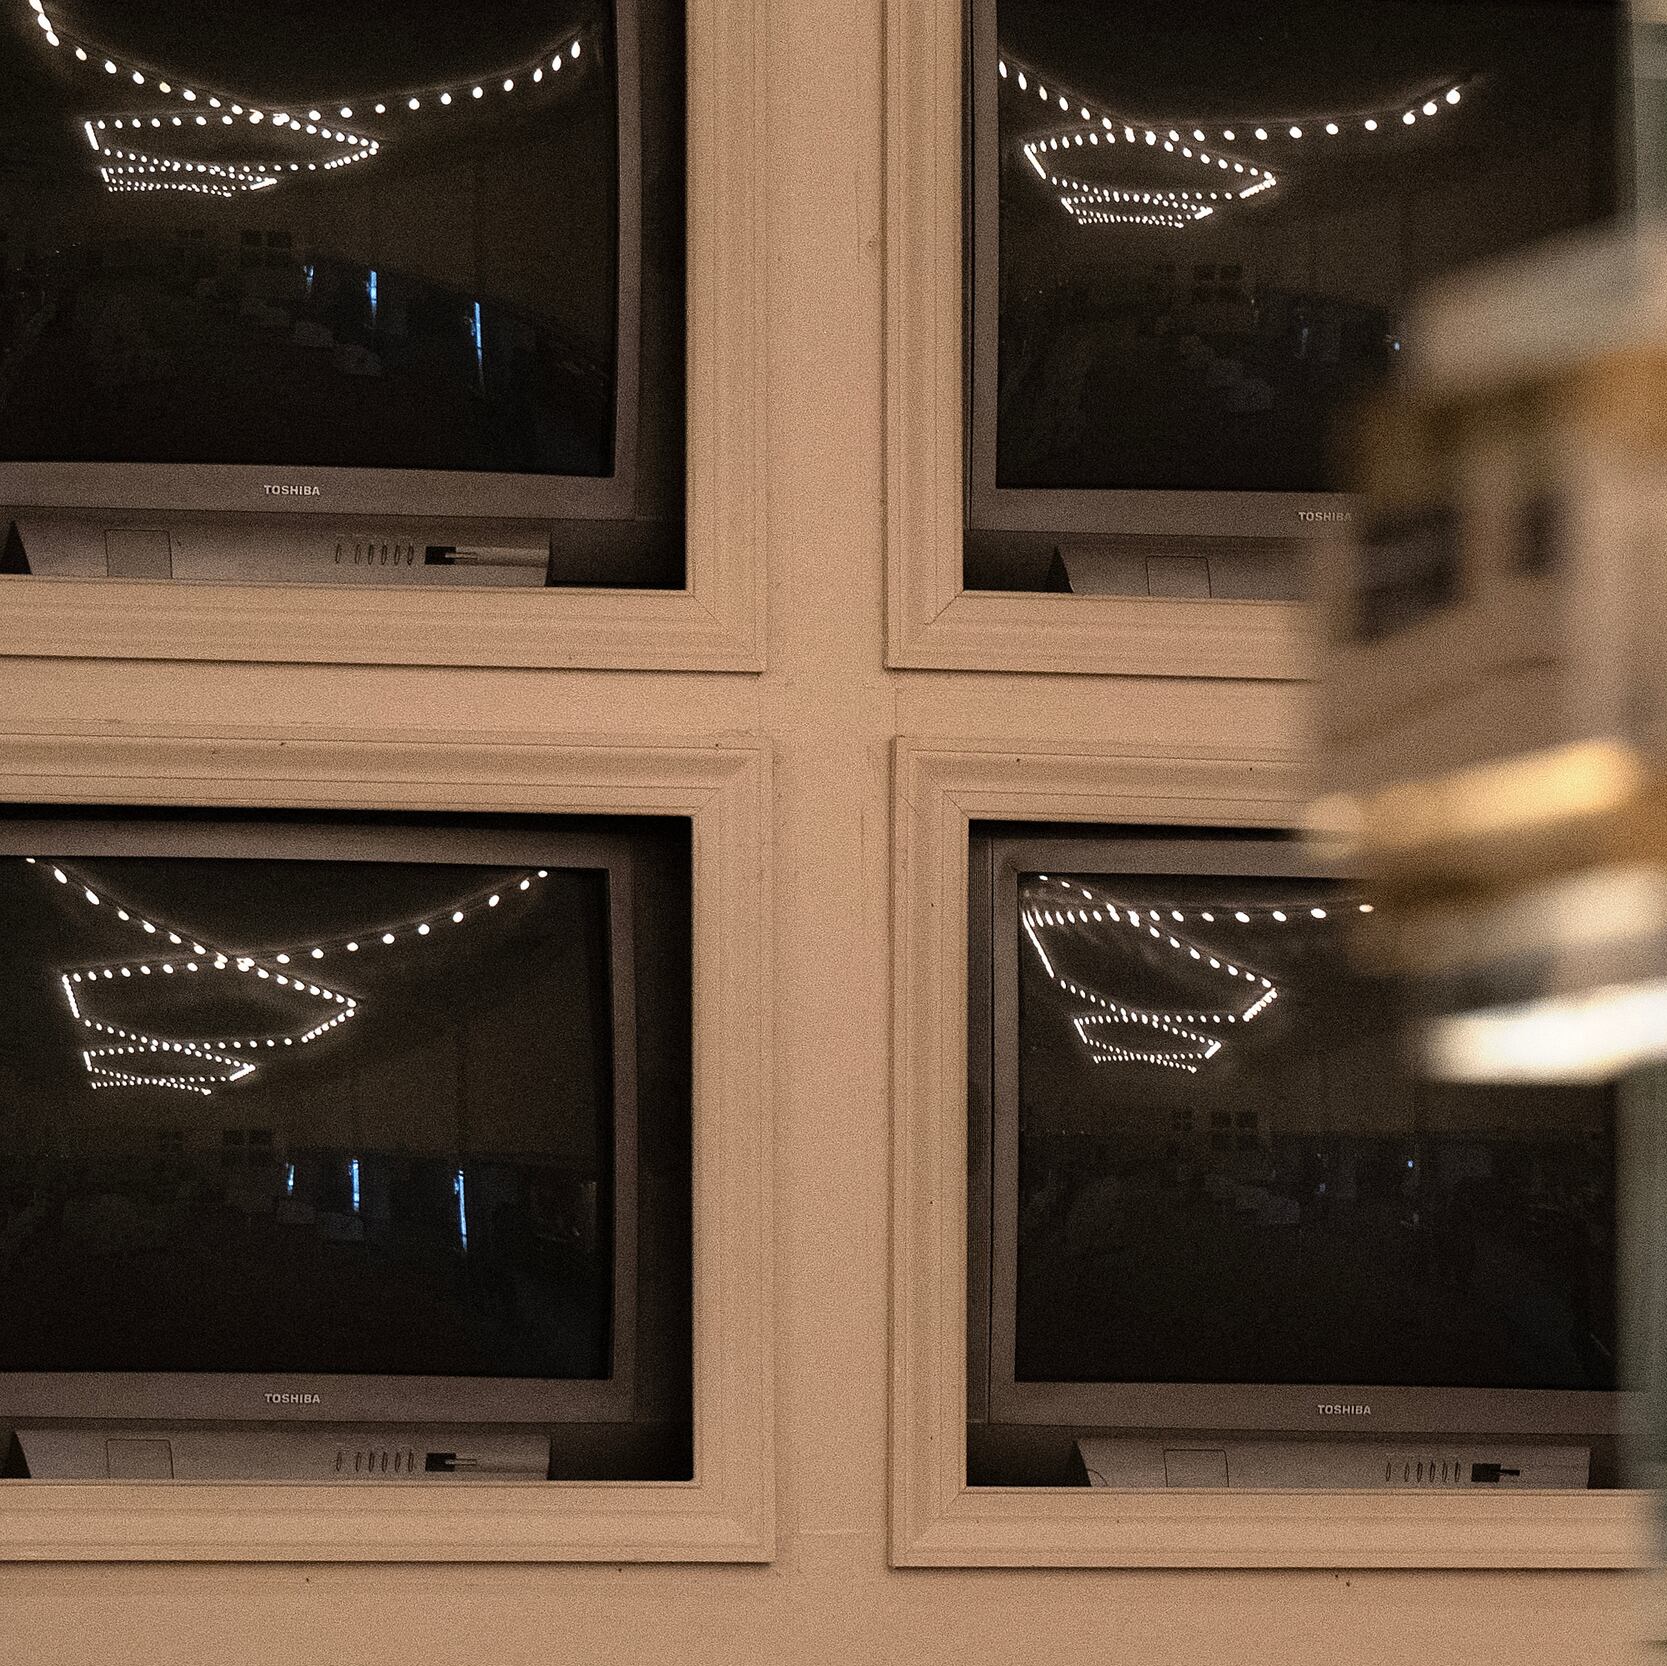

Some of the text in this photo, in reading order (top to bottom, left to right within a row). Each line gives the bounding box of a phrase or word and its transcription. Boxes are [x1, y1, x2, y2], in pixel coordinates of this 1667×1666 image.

[263, 484, 321, 496] TOSHIBA
[1298, 511, 1352, 522] TOSHIBA
[263, 1393, 321, 1404] TOSHIBA
[1317, 1404, 1371, 1415] TOSHIBA
